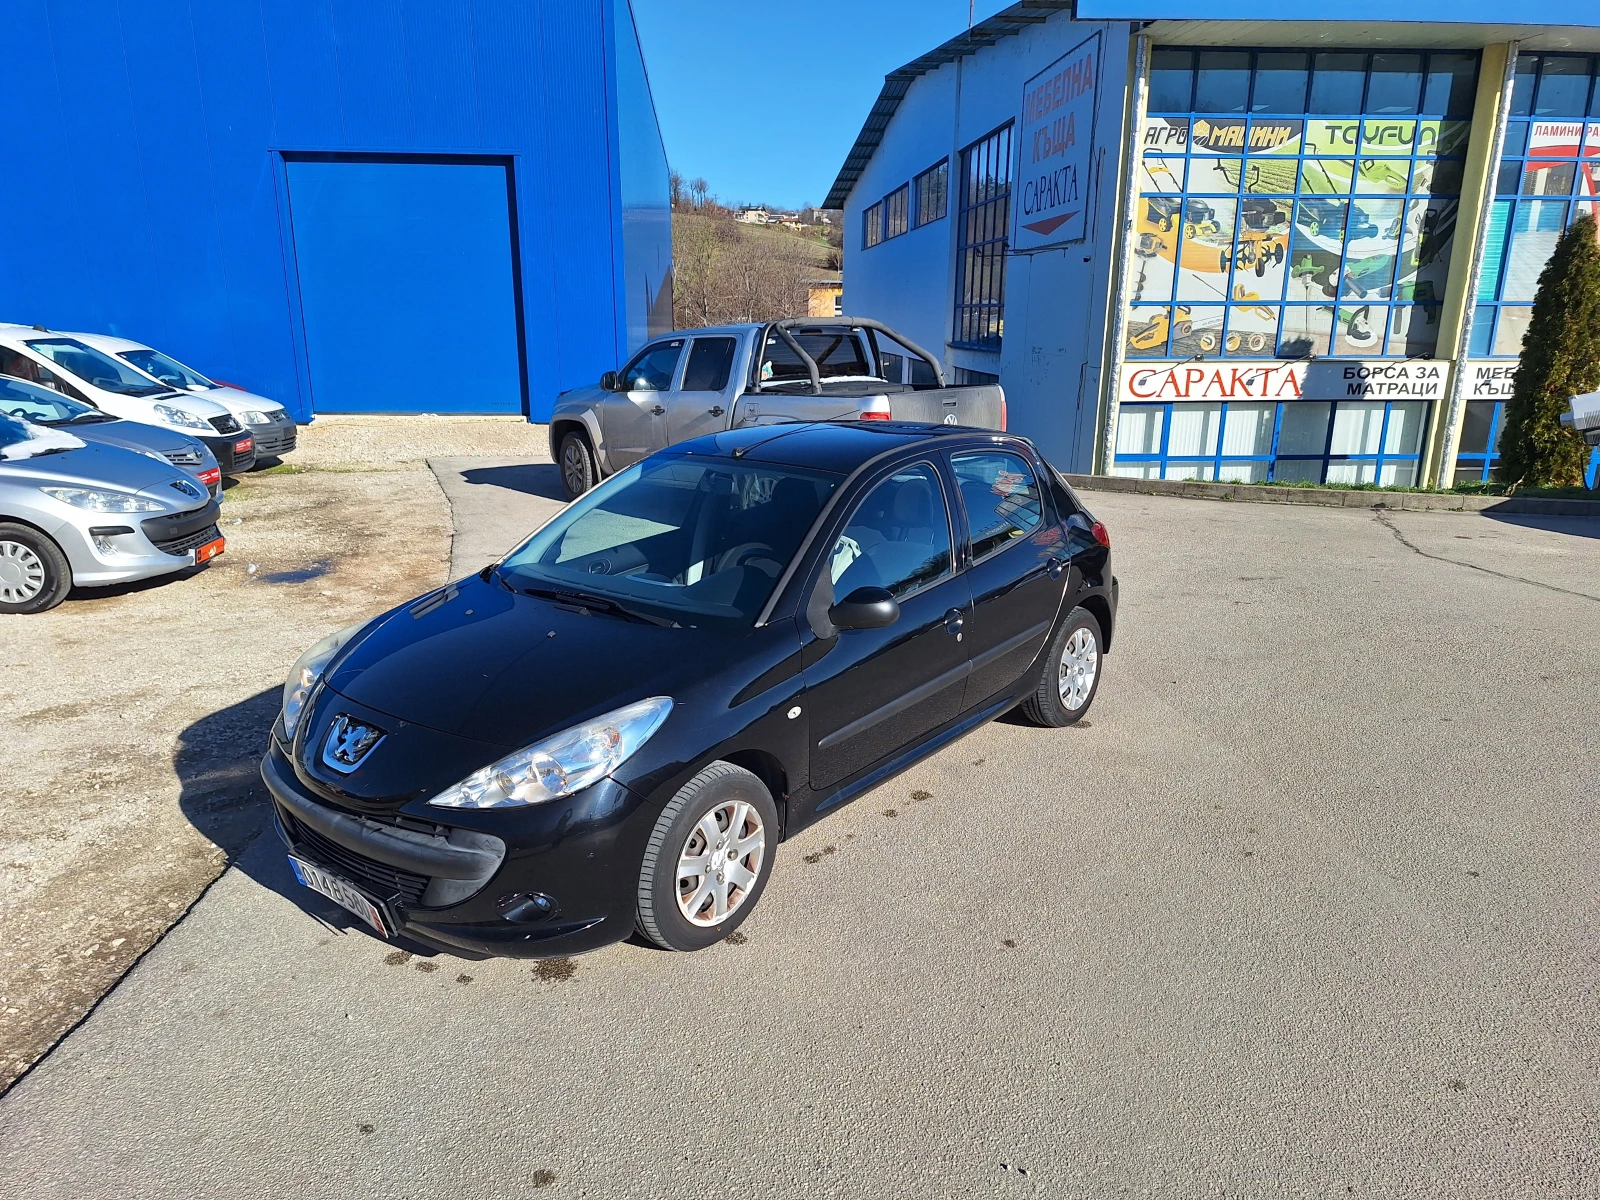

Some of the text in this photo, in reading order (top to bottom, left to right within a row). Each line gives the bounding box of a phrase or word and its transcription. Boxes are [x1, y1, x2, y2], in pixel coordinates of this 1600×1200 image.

[1025, 53, 1093, 126] МЕБЕЛНА
[1032, 111, 1076, 164] КЪЩА
[1144, 126, 1188, 145] АГРО
[1534, 125, 1600, 138] ЛАМИНИРА
[1023, 163, 1079, 216] САРАКТА
[1343, 366, 1440, 380] БОРСА ЗА
[1476, 367, 1515, 379] МЕБ
[1128, 368, 1303, 398] САРАКТА
[1346, 382, 1438, 397] МАТРАЦИ
